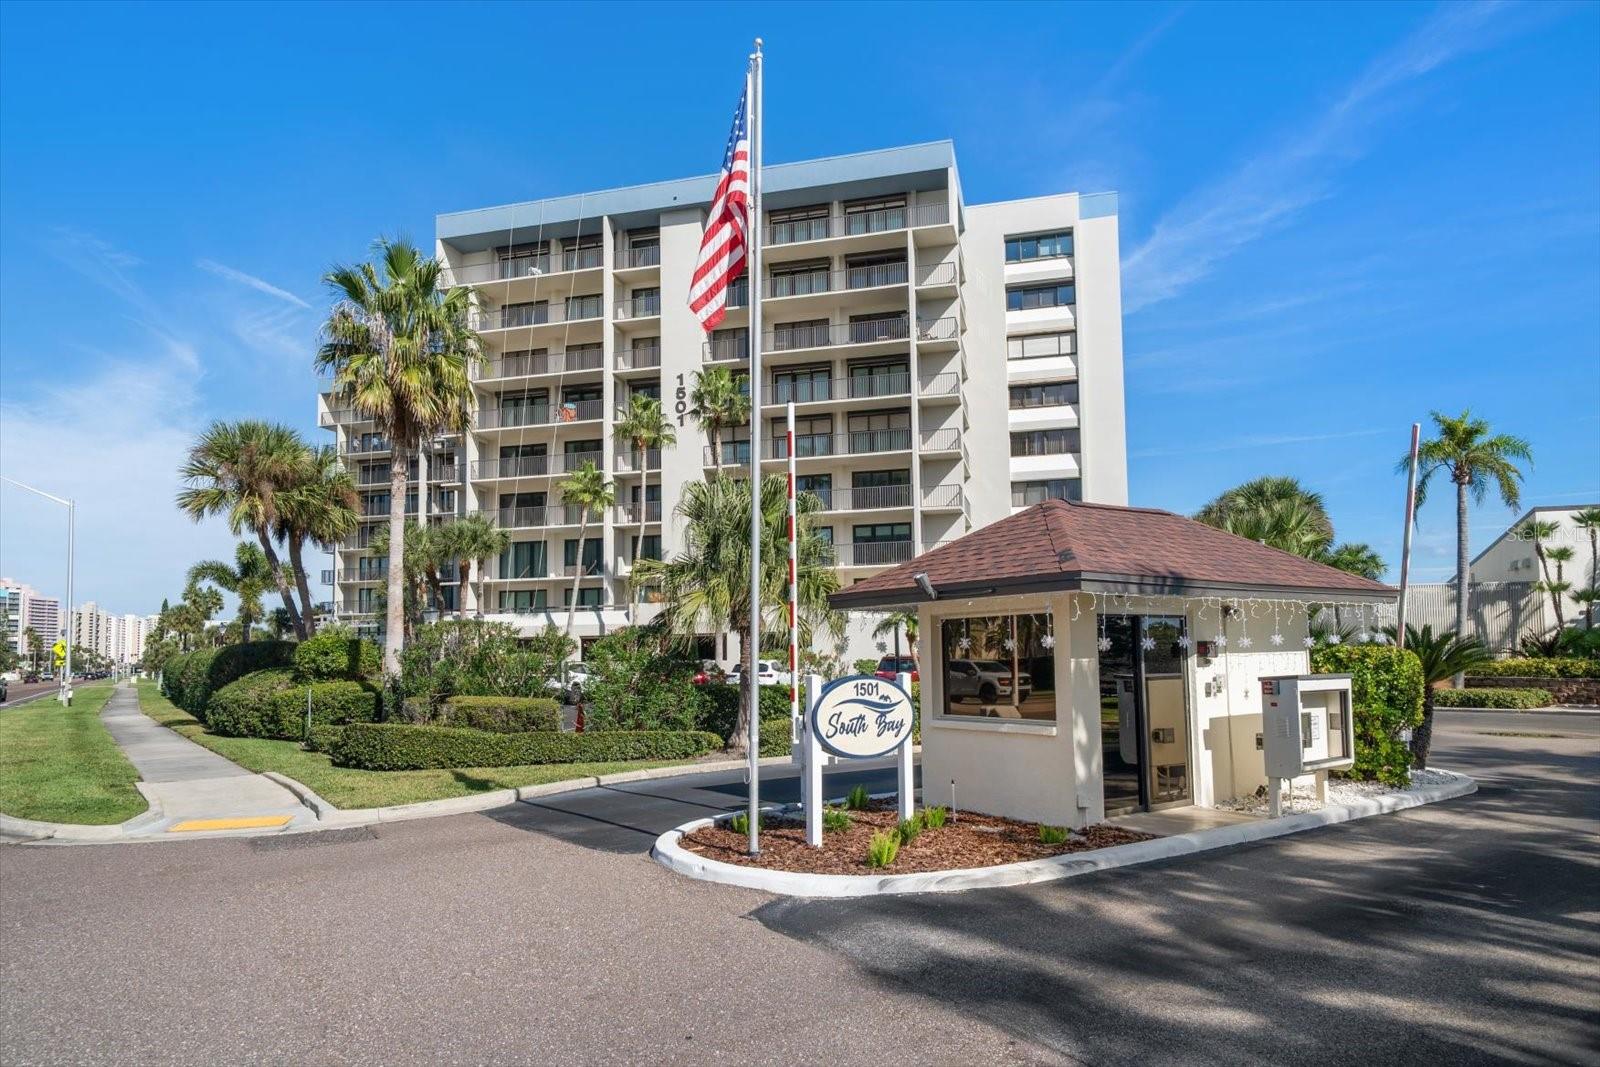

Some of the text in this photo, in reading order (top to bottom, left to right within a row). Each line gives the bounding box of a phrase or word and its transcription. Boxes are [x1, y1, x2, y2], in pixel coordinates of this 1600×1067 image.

[675, 373, 687, 427] 1501
[853, 682, 880, 697] 1501
[825, 711, 905, 739] South Bay
